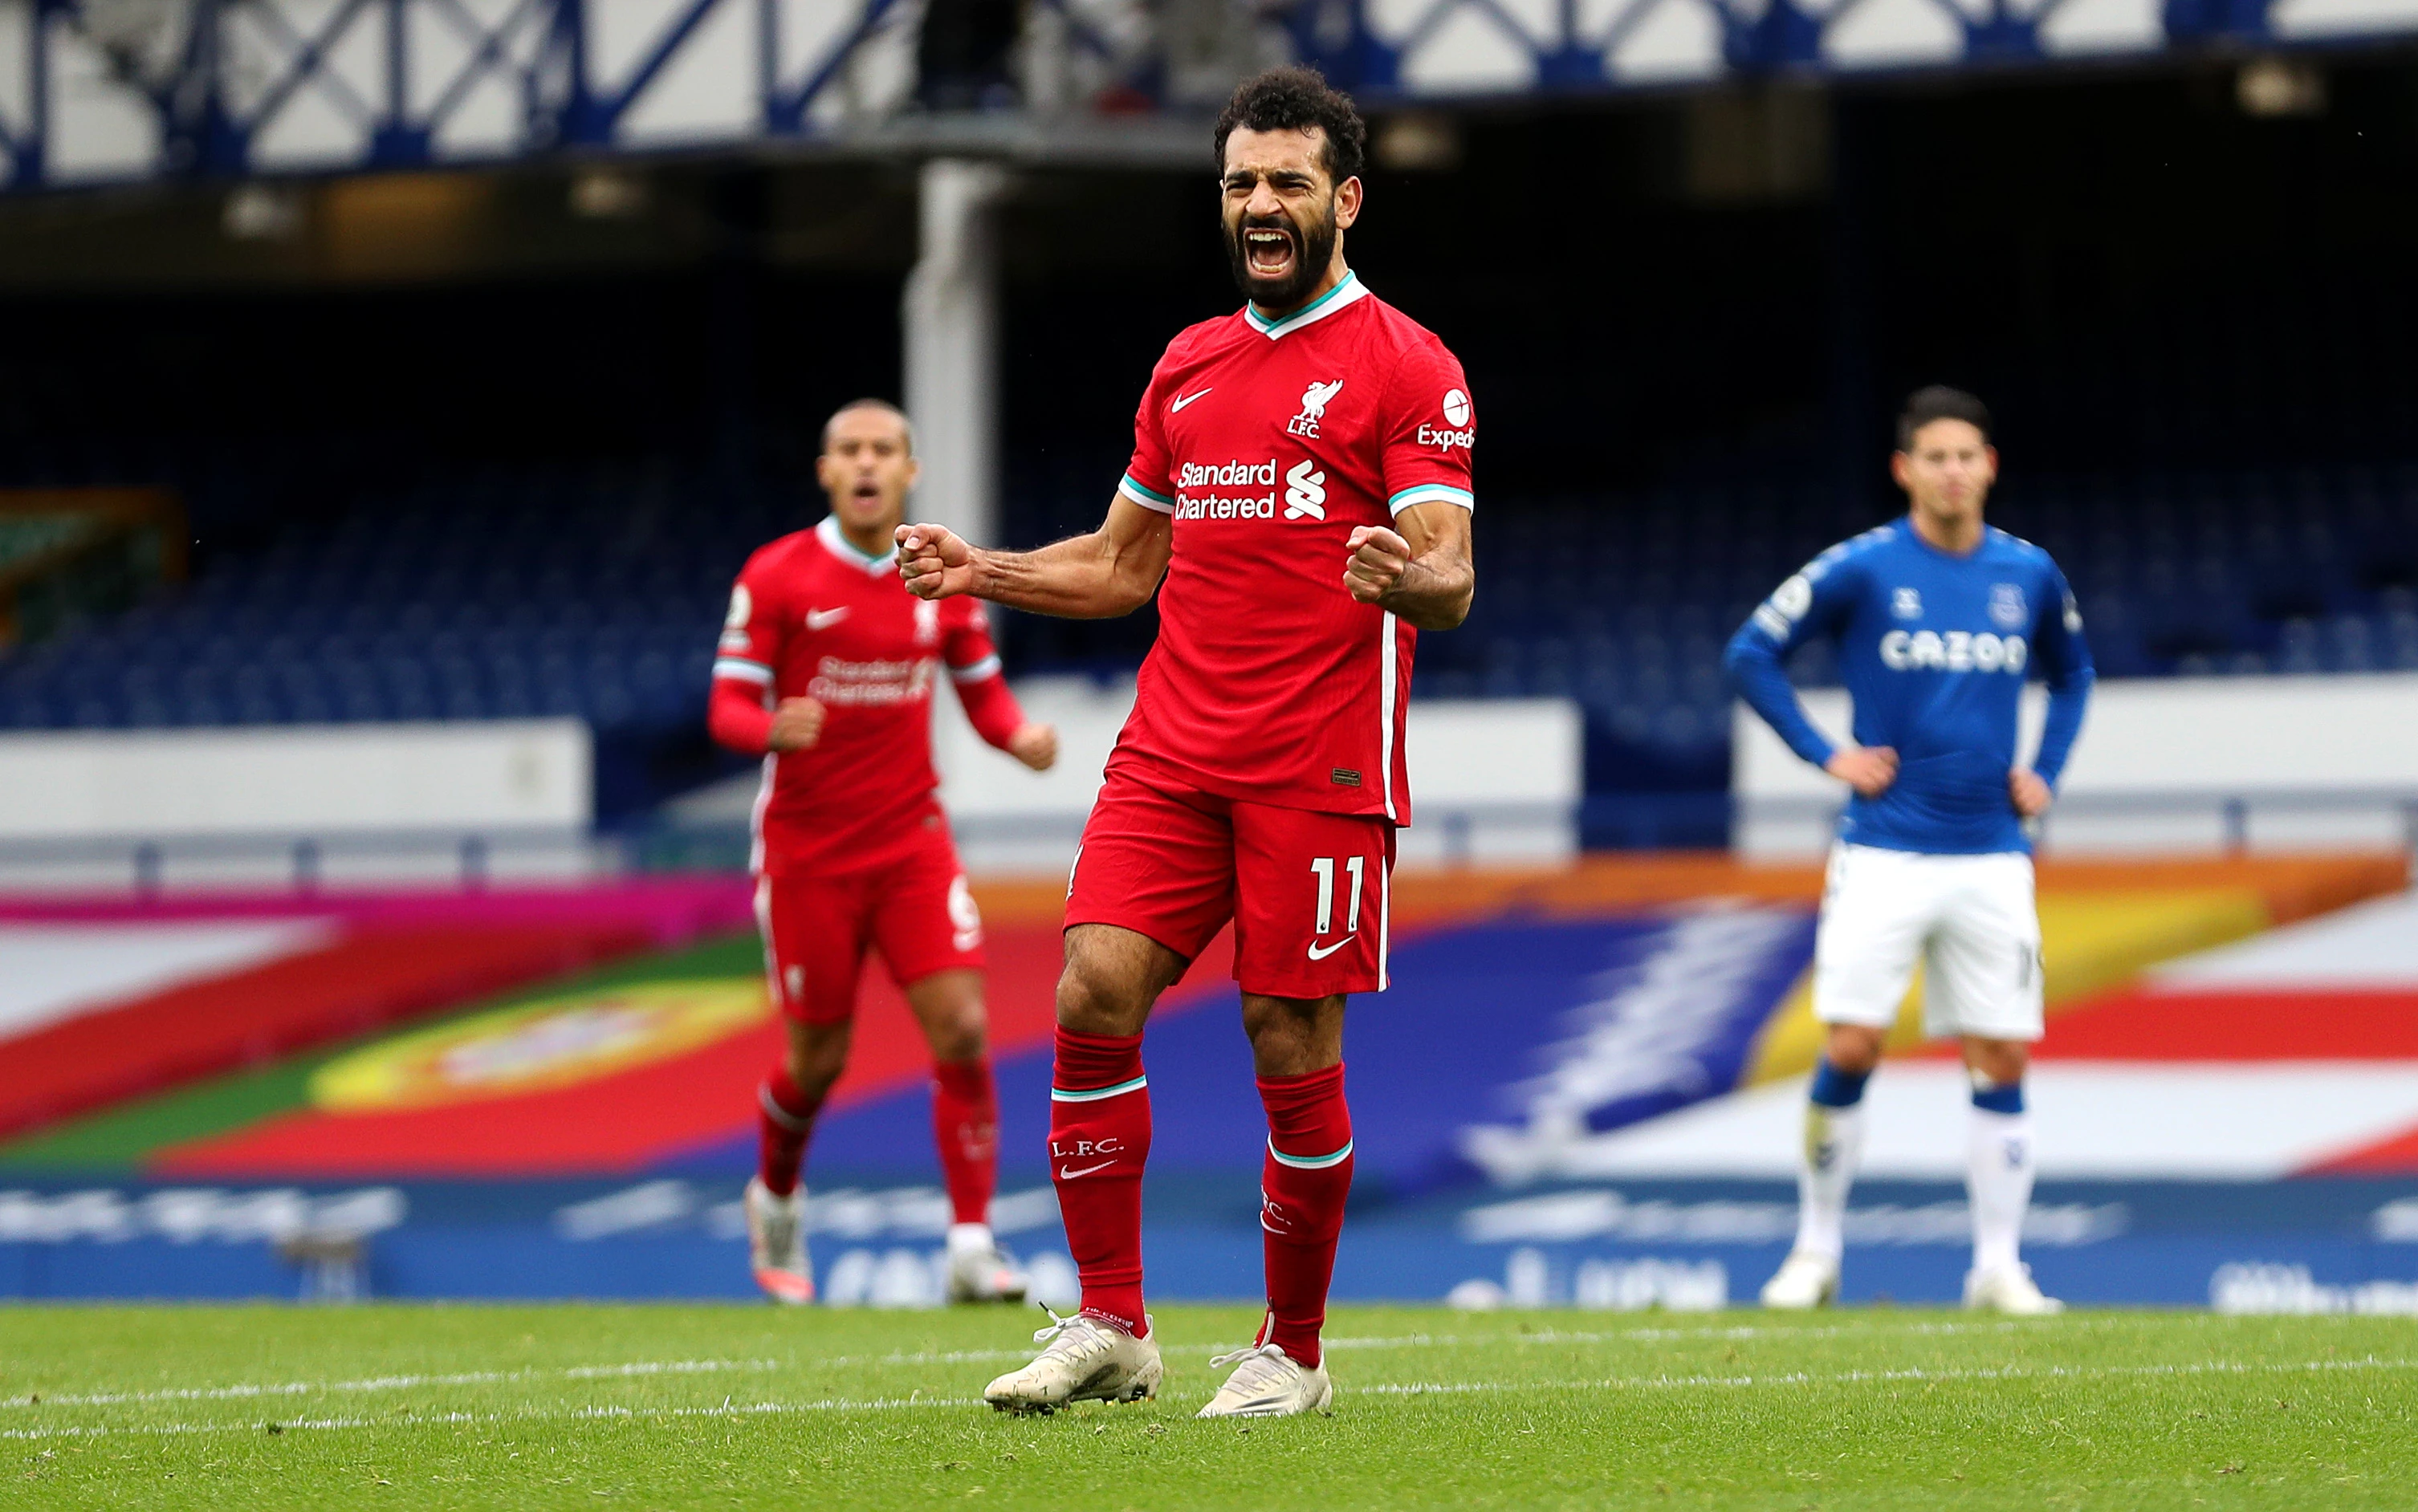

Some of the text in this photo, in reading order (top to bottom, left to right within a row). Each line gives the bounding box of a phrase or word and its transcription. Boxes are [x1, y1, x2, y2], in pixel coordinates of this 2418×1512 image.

[1287, 419, 1320, 439] L.F.C.
[1177, 458, 1276, 489] Standard
[1174, 492, 1275, 520] Chartered
[1879, 629, 2028, 675] CAZOO
[1310, 856, 1364, 934] 11
[1052, 1137, 1125, 1157] L.F.C.
